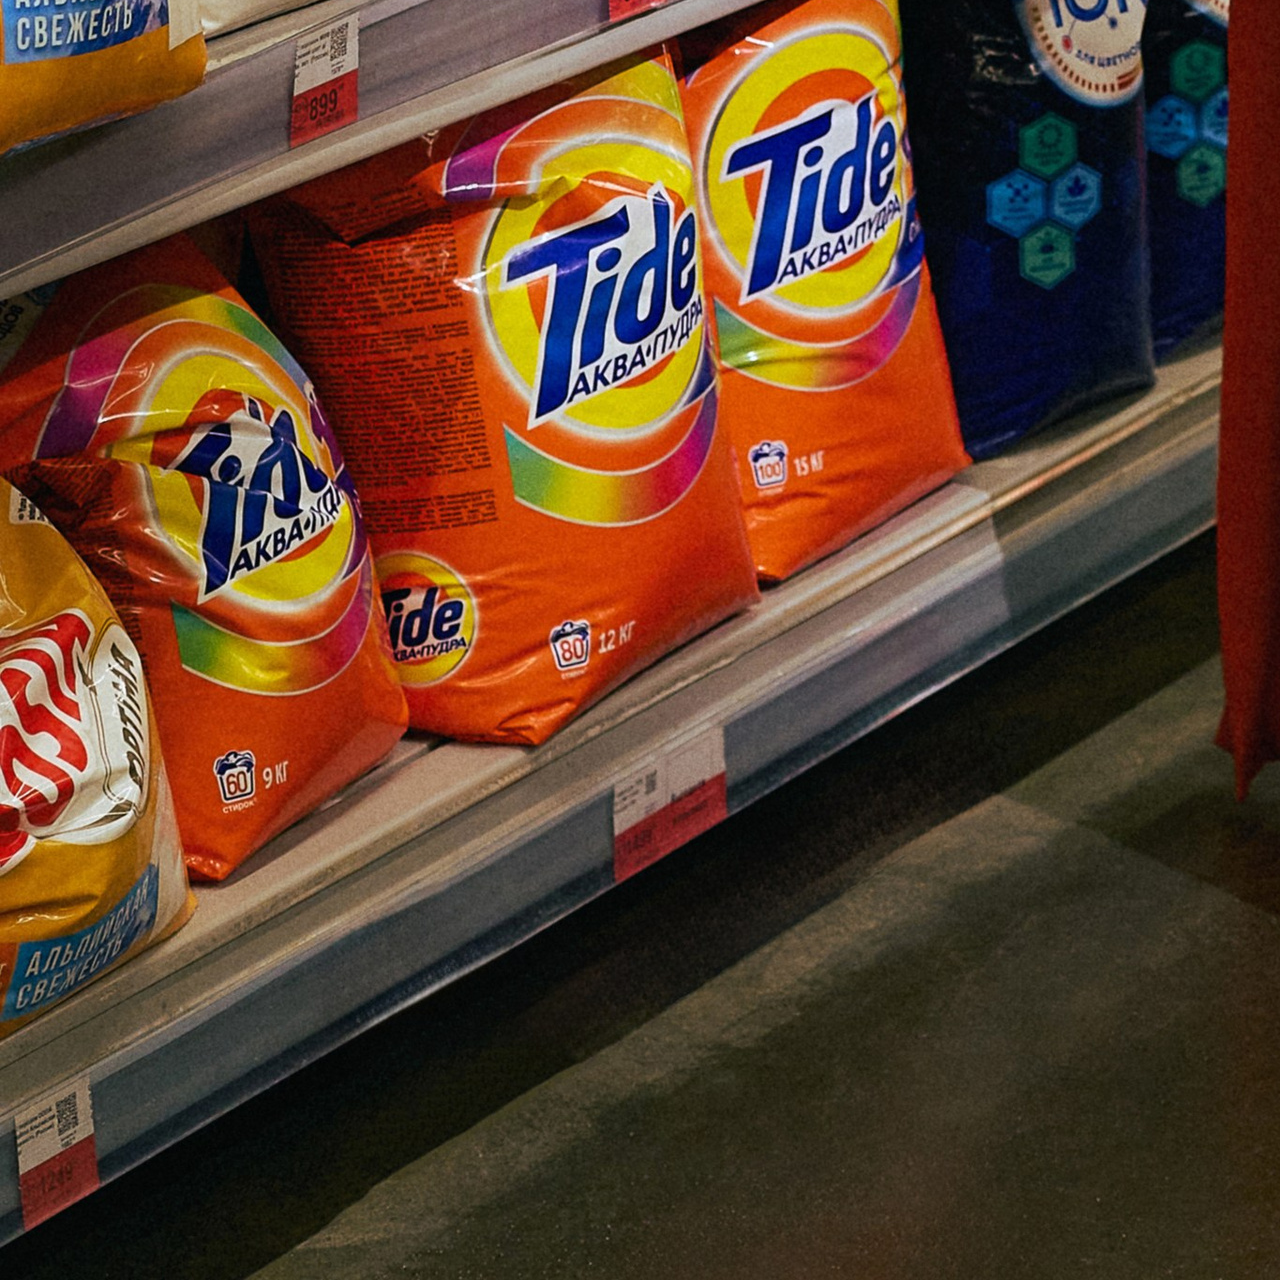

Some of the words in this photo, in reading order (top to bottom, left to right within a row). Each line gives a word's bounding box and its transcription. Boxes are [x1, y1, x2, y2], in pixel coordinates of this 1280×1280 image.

[308, 88, 338, 121] 899
[726, 95, 896, 297] Tide
[506, 196, 697, 421] Tide
[759, 462, 782, 480] 100
[793, 454, 810, 477] 15
[560, 638, 585, 662] 80
[598, 626, 616, 653] 12
[618, 620, 637, 643] КГ
[225, 771, 247, 794] 60
[262, 769, 273, 789] 9
[275, 761, 289, 783] КГ
[222, 798, 254, 814] стирок
[26, 875, 150, 976] АЛЬПИЙСКАЯ
[16, 937, 123, 1010] СВЕЖЕСТЬ
